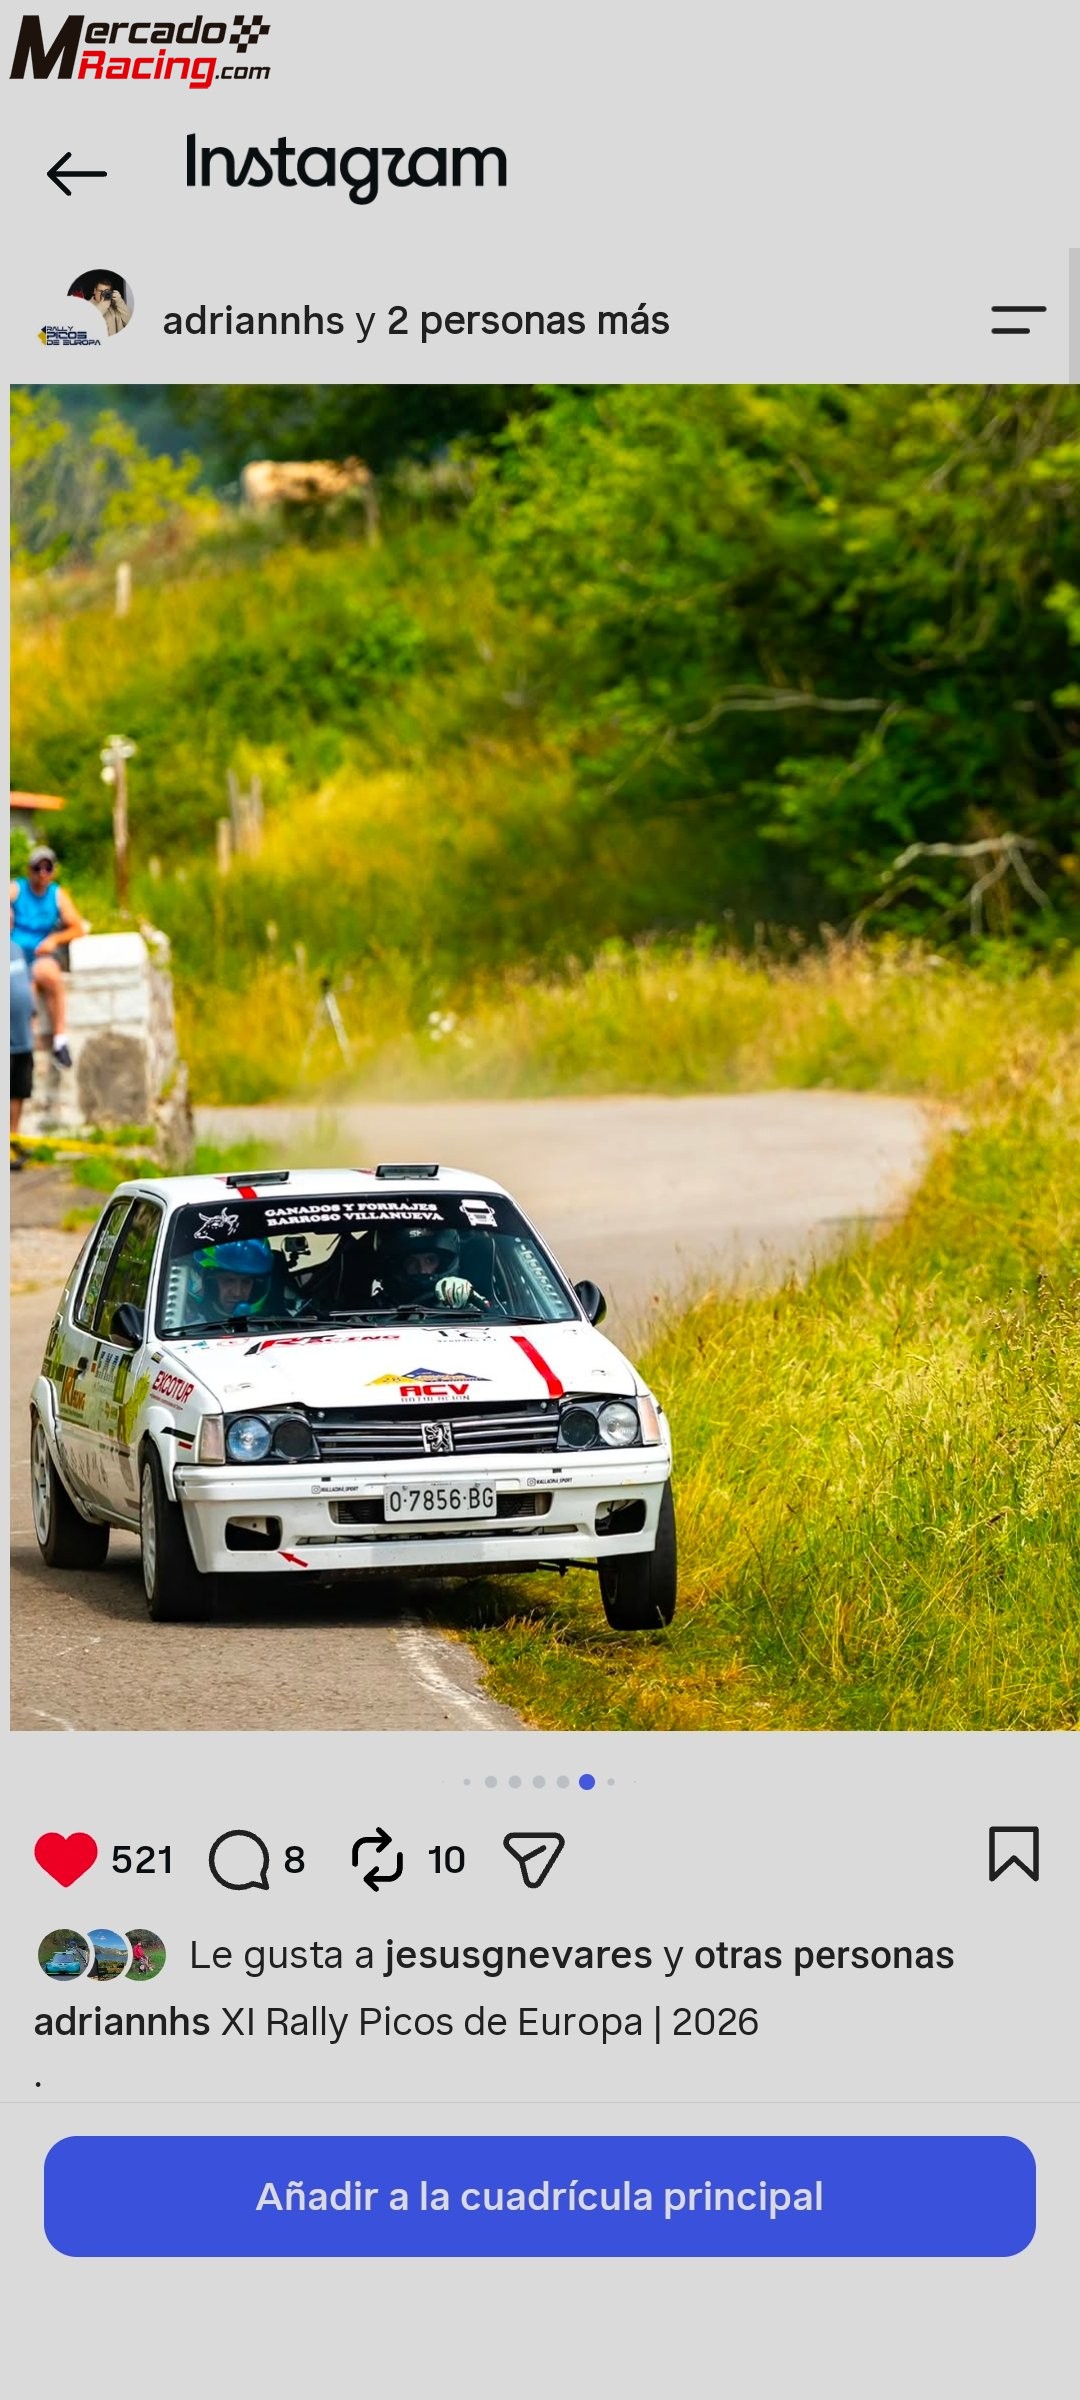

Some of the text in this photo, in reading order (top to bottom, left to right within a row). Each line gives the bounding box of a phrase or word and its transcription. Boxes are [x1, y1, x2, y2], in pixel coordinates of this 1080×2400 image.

[186, 133, 508, 206] Instagram
[46, 331, 88, 340] PICOS
[163, 303, 670, 344] adriannhs y 2 personas más
[264, 1202, 438, 1218] GANADOS Y FORRAJES
[266, 1211, 445, 1227] BARROSO VILLANUEVA
[151, 1370, 194, 1404] EXCOTUR
[399, 1383, 470, 1397] ACV
[111, 1845, 171, 1874] 521
[284, 1845, 306, 1874] 8
[428, 1845, 466, 1874] 10
[191, 1939, 955, 1978] Le gusta a jesusgnevares y otras personas
[34, 2005, 211, 2036] adriannhs
[221, 2007, 254, 2036] XI
[267, 2005, 349, 2045] Rally
[360, 2005, 454, 2036] Picos
[464, 2005, 507, 2036] de
[519, 2007, 642, 2045] Europa
[672, 2007, 759, 2036] 2026
[255, 2178, 823, 2221] Añadir a la cuadrícula principal
